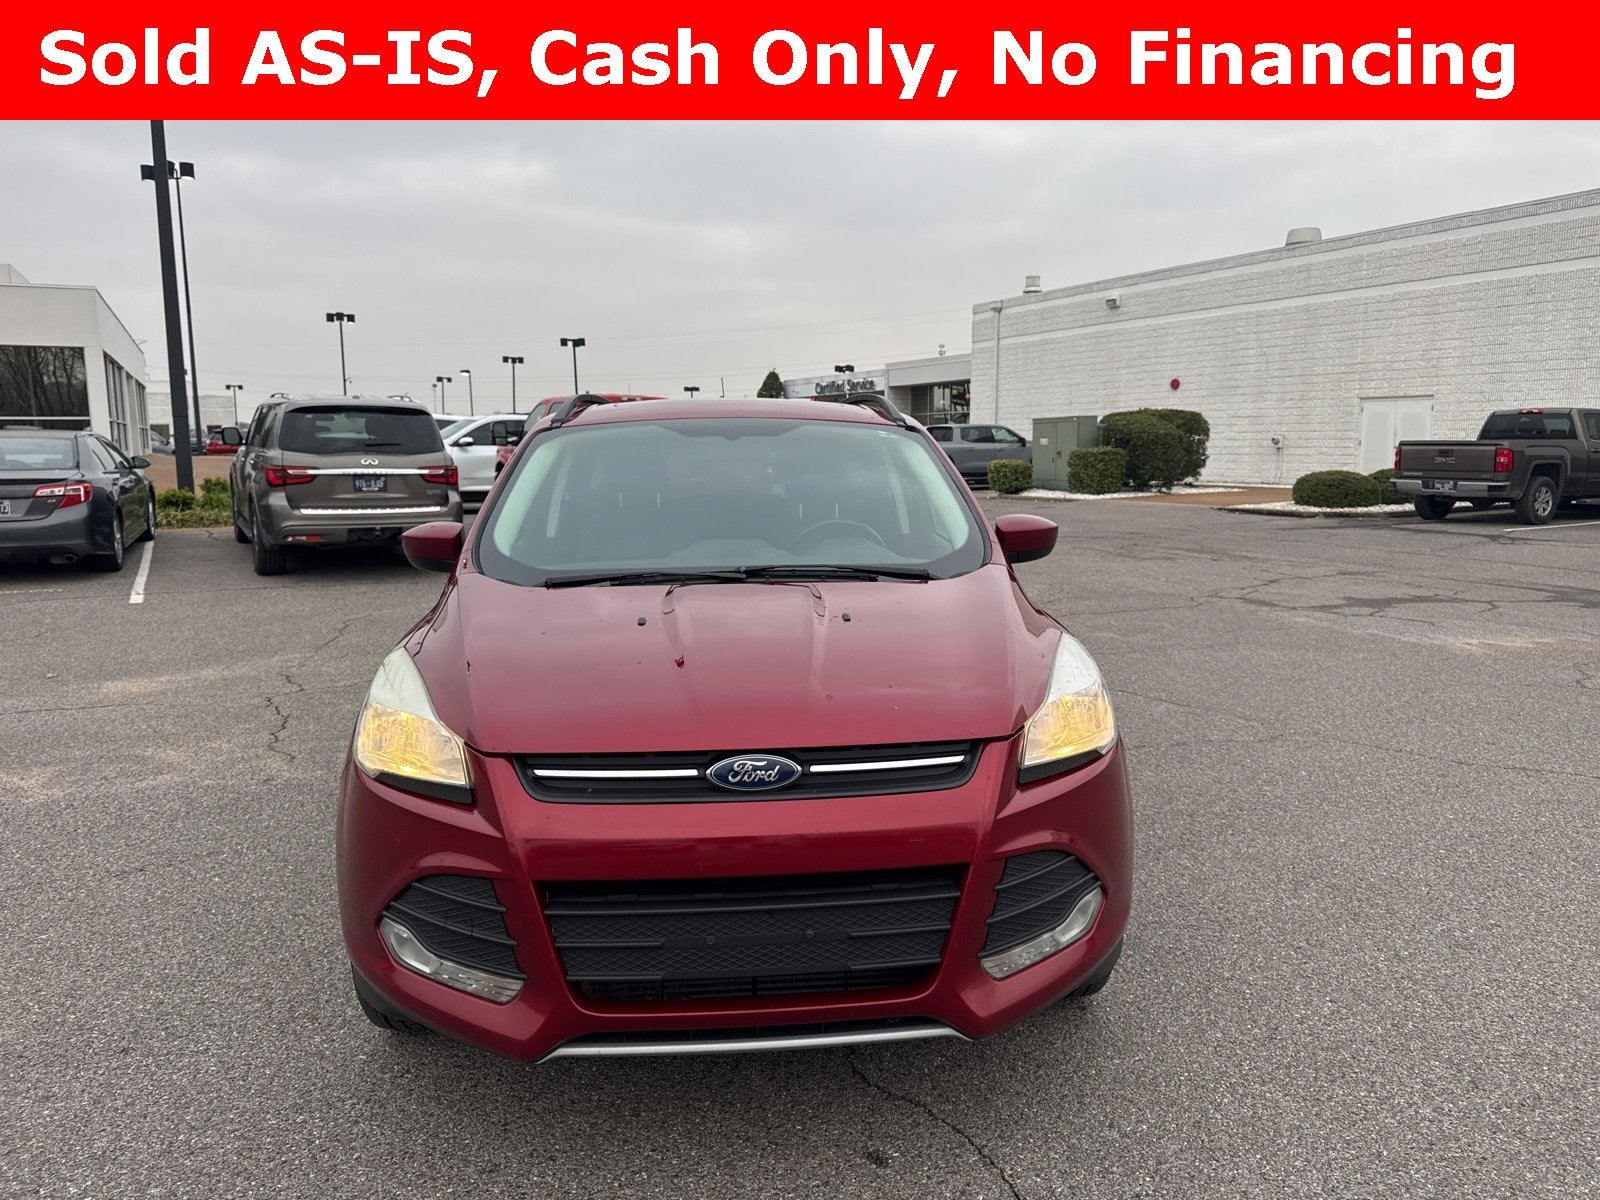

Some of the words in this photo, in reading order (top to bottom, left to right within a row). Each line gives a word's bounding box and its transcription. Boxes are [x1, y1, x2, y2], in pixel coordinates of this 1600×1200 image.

[815, 379, 845, 394] Certified
[847, 378, 876, 391] Service
[728, 760, 781, 783] Ford
